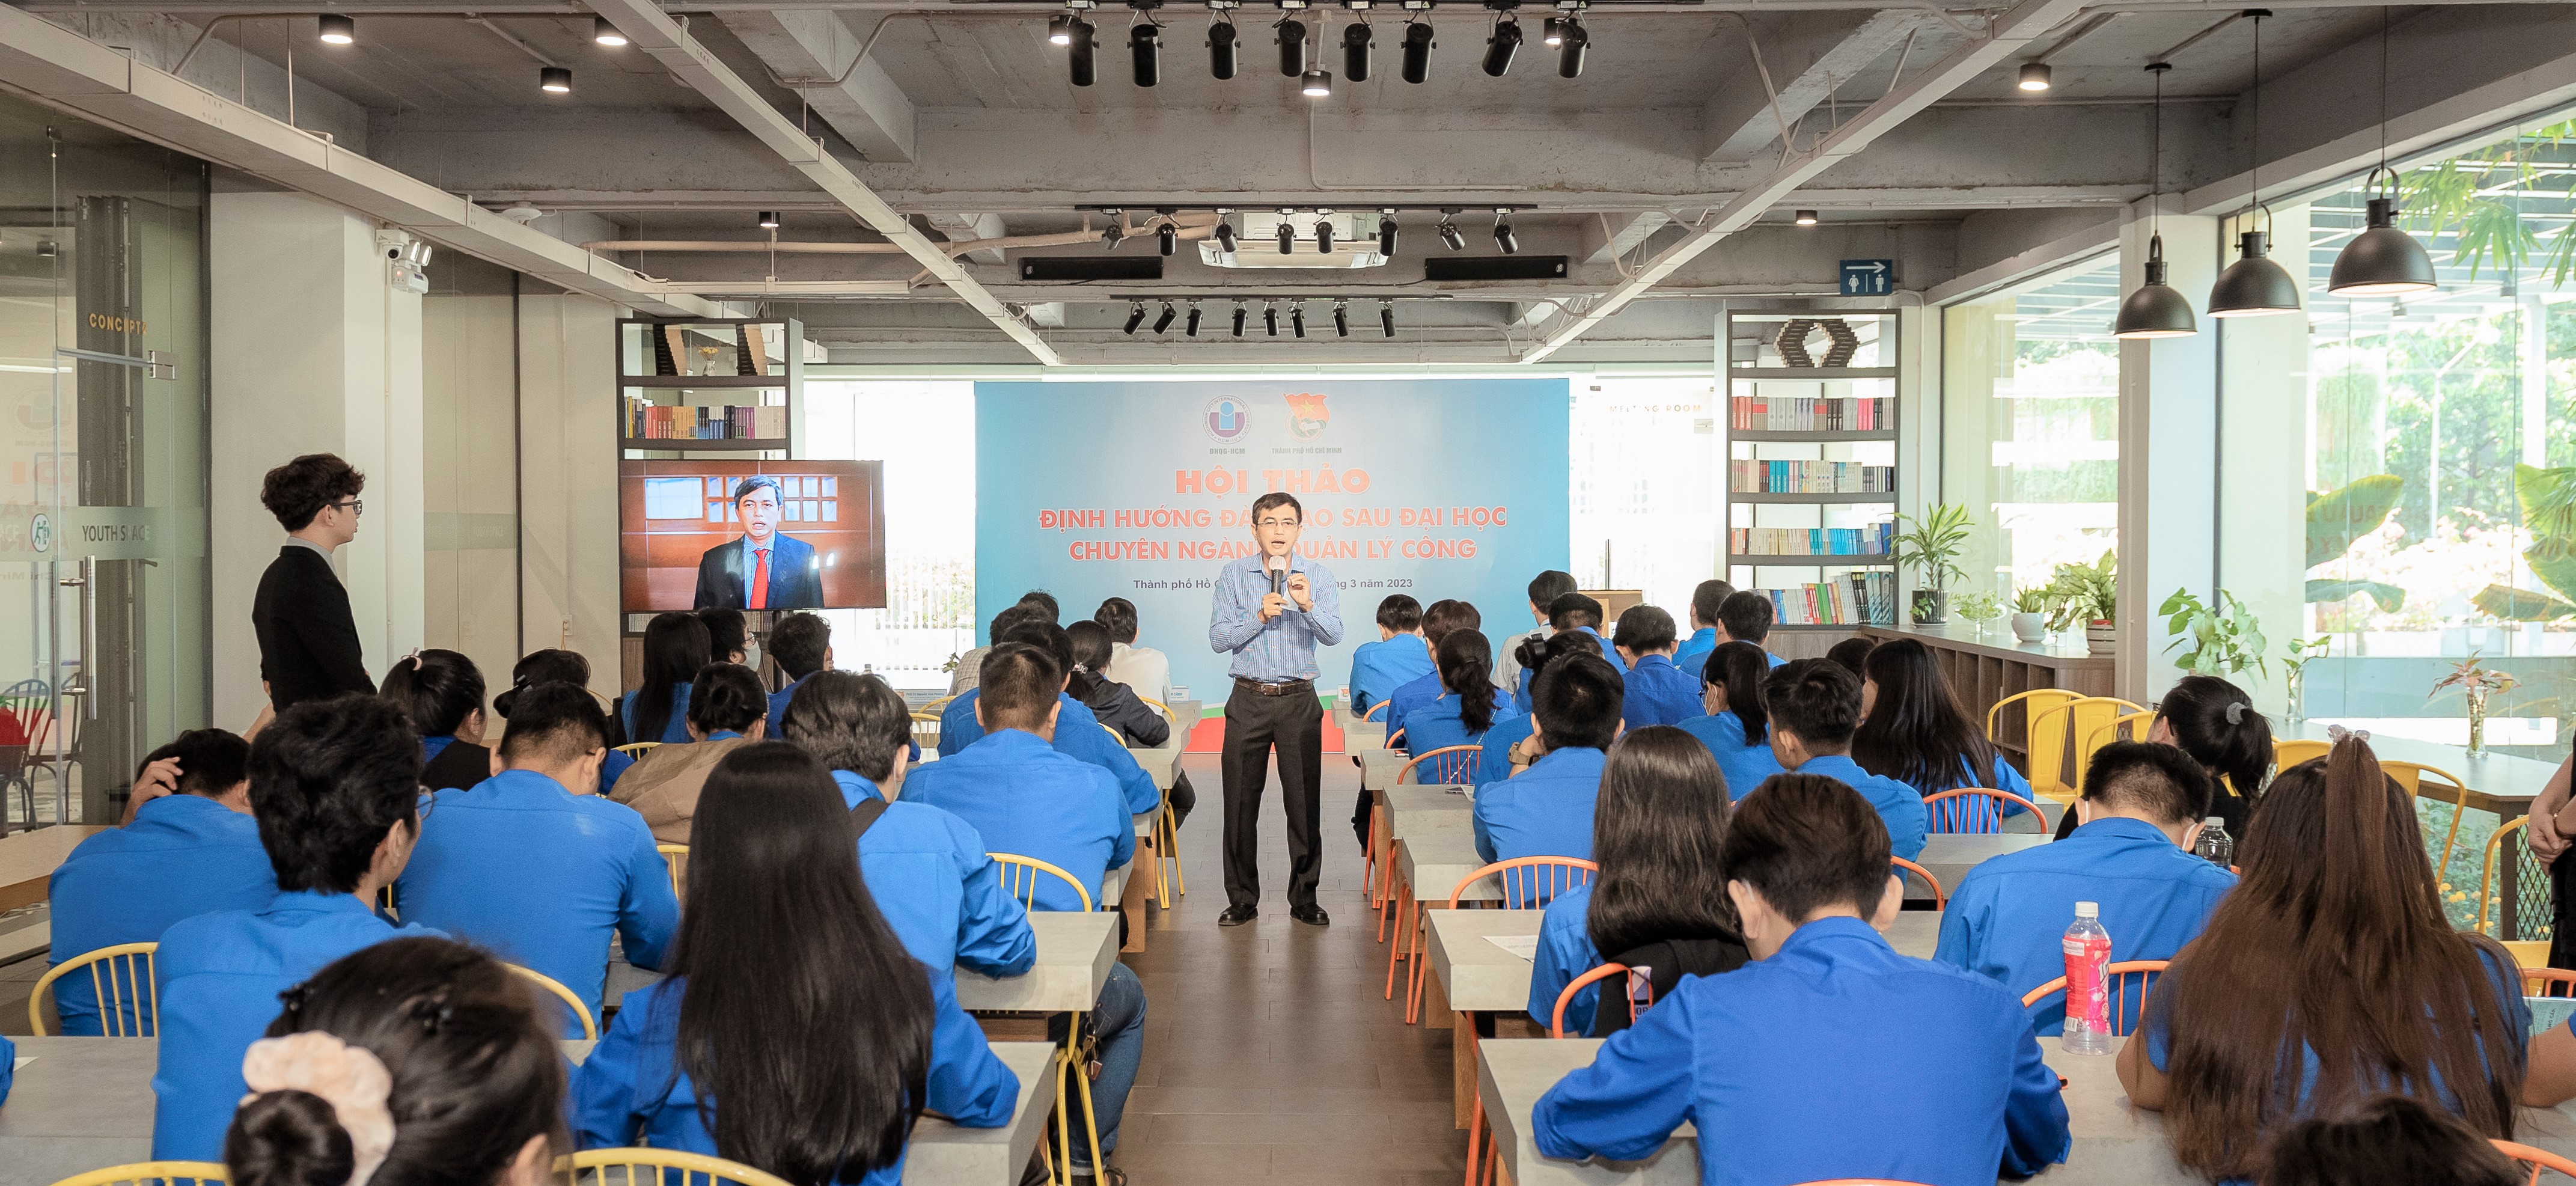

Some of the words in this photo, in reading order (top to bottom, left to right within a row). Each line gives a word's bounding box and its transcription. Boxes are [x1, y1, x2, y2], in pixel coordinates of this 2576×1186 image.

[1176, 465, 1248, 500] HỘI
[1262, 463, 1371, 495] THẢO
[1039, 509, 1105, 533] ĐỊNH
[1114, 504, 1213, 528] HƯỚNG
[1219, 504, 1253, 528] ĐÀ
[1301, 507, 1335, 533] ẠO
[1342, 507, 1392, 528] SAU
[1399, 507, 1444, 531] ĐẠI
[1451, 506, 1507, 531] HỌC
[82, 525, 118, 542] YOUTH
[1069, 537, 1169, 561] CHUYÊN
[1177, 537, 1262, 560] NGÀN
[1366, 535, 1396, 560] LÝ
[1400, 536, 1478, 560] CÔNG
[1134, 579, 1168, 588] Thành
[1171, 578, 1192, 591] phố
[1195, 578, 1211, 588] Hồ
[1351, 579, 1357, 588] 3
[1360, 578, 1384, 588] năm
[1387, 579, 1413, 588] 2023
